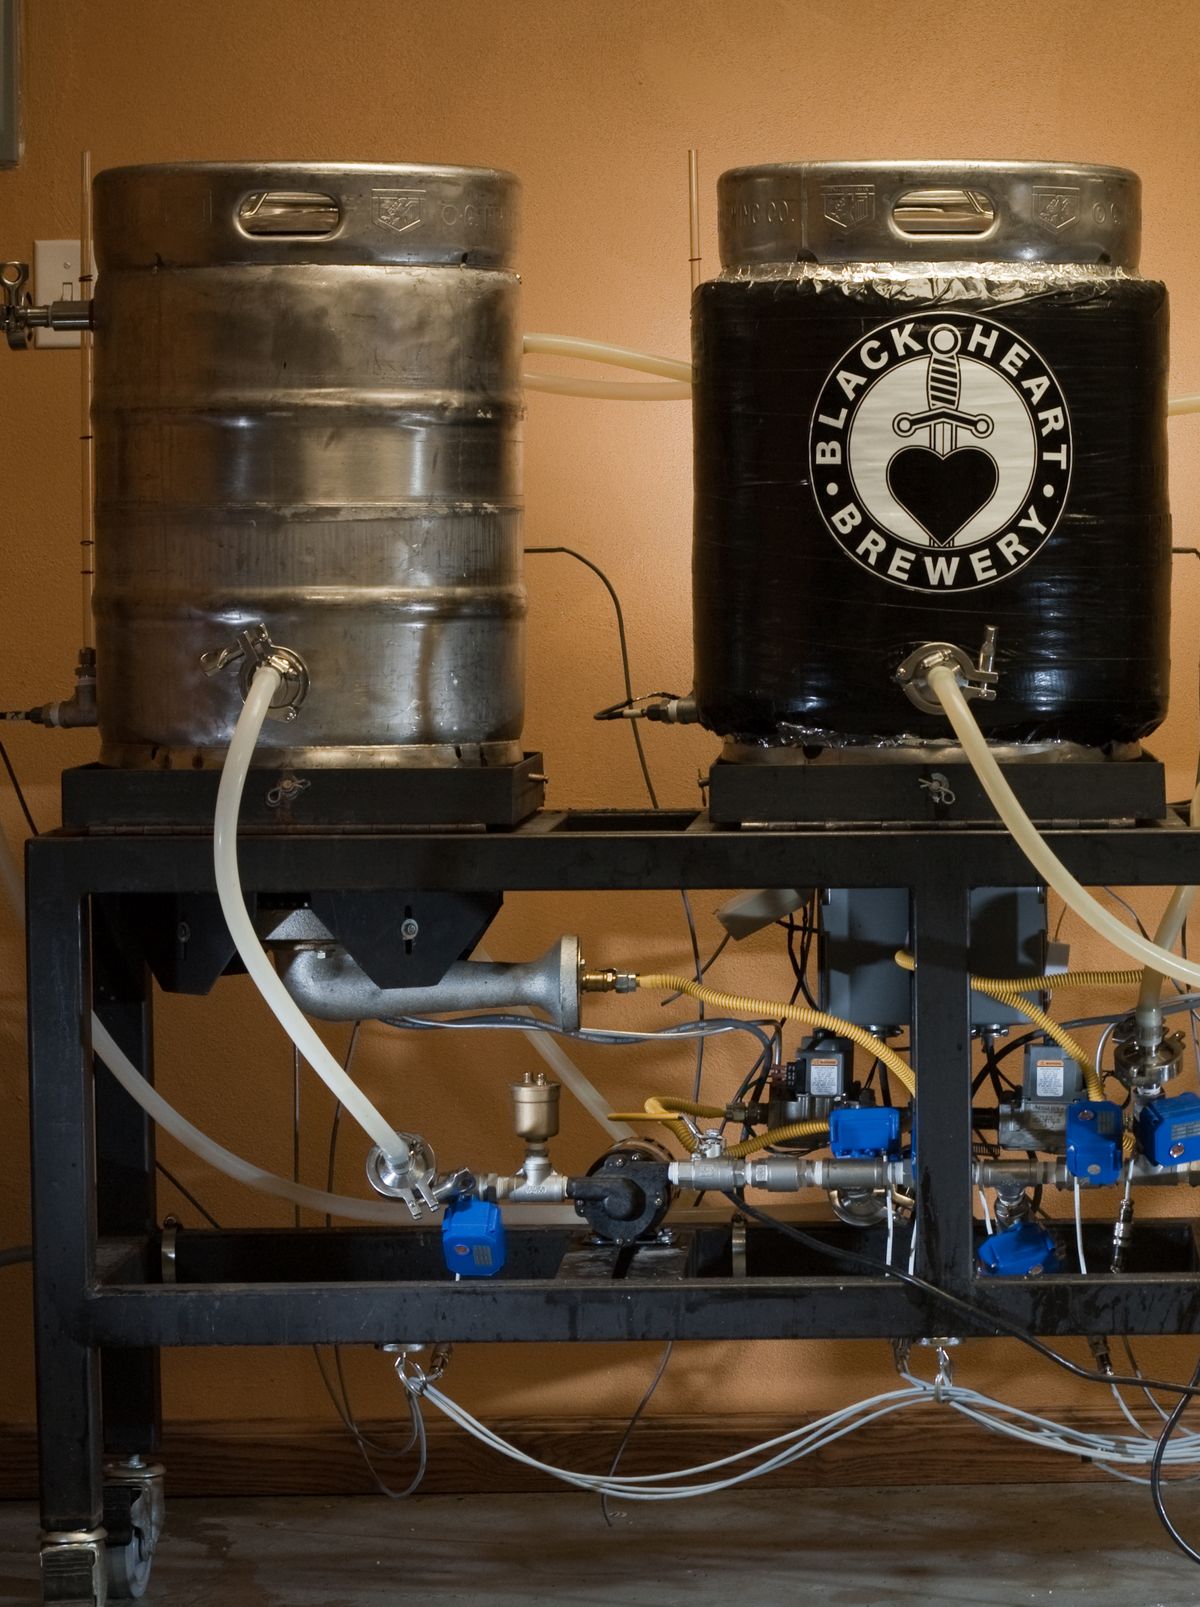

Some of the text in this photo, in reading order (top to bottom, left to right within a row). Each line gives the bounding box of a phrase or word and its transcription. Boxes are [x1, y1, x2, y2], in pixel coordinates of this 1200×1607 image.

[815, 322, 924, 465] BLACK
[967, 323, 1068, 470] HEART
[830, 502, 1048, 586] BREWERY
